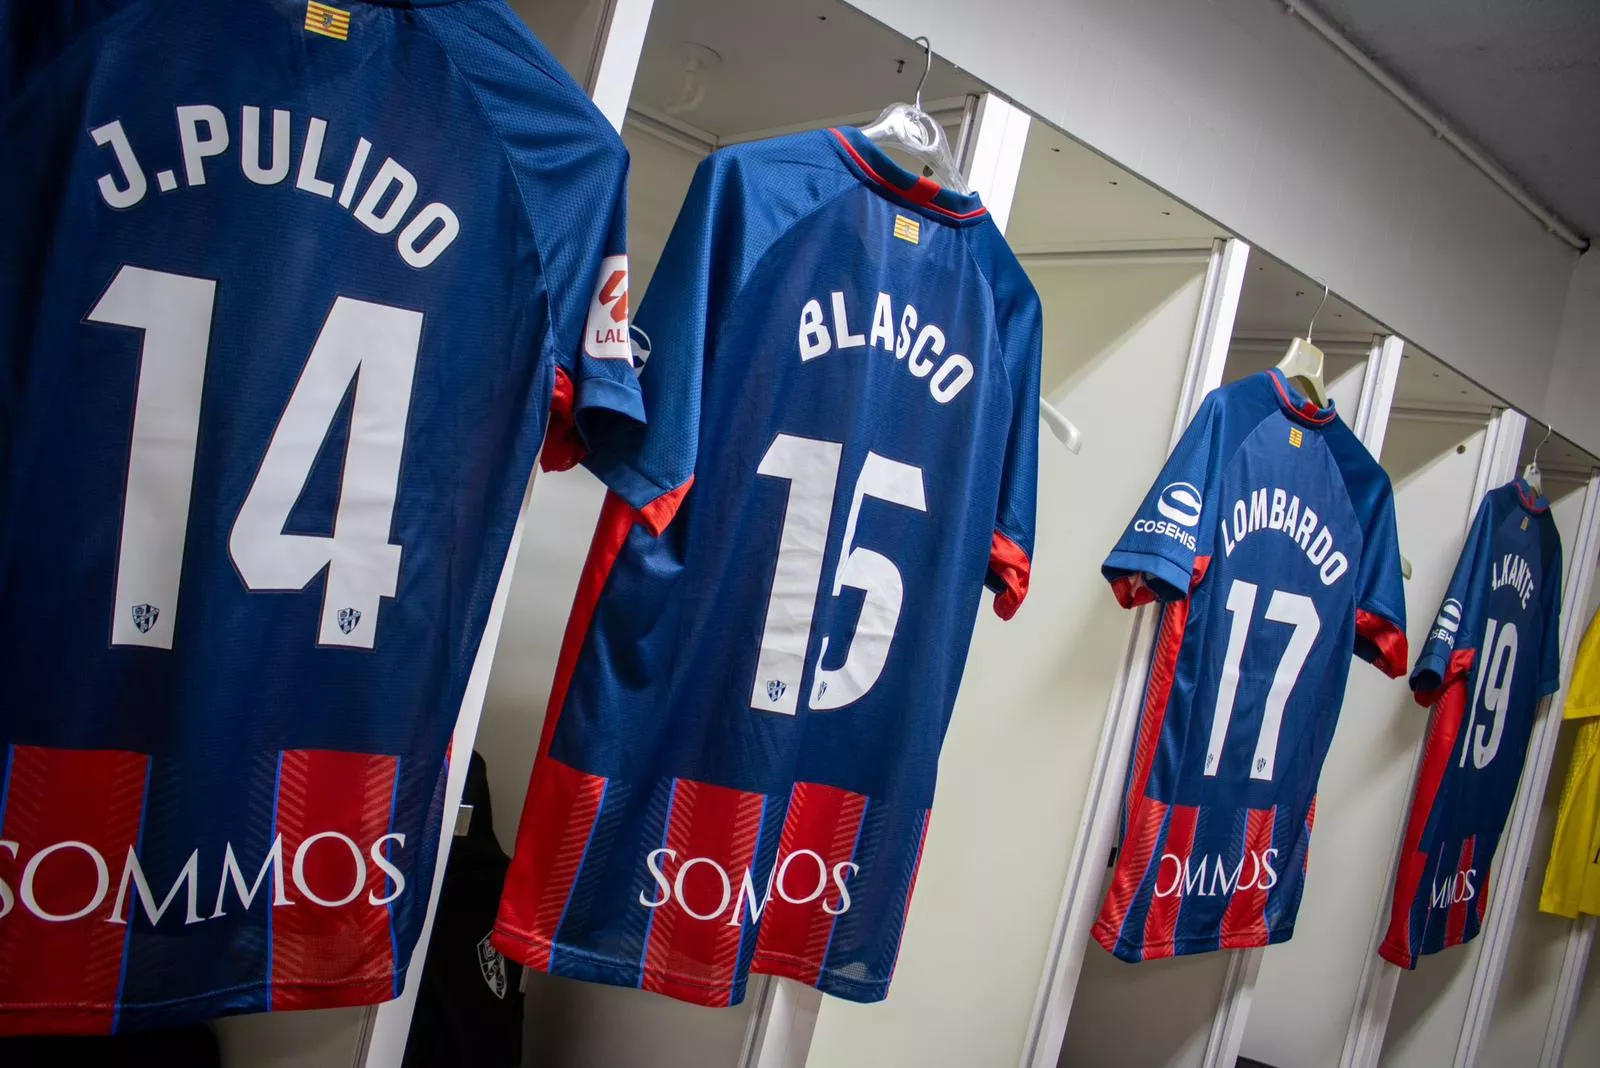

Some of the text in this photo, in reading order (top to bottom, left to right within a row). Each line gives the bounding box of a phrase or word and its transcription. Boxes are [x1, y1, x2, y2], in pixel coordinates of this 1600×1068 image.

[90, 104, 461, 270] J.PULIDO
[595, 328, 628, 344] LAL
[799, 291, 974, 404] BLASCO
[86, 264, 425, 650] 14
[750, 433, 927, 716] 15
[1134, 519, 1197, 552] COSEHIS
[1221, 487, 1348, 586] LOMBARDO
[1204, 579, 1321, 781] 17
[1459, 617, 1518, 769] 19
